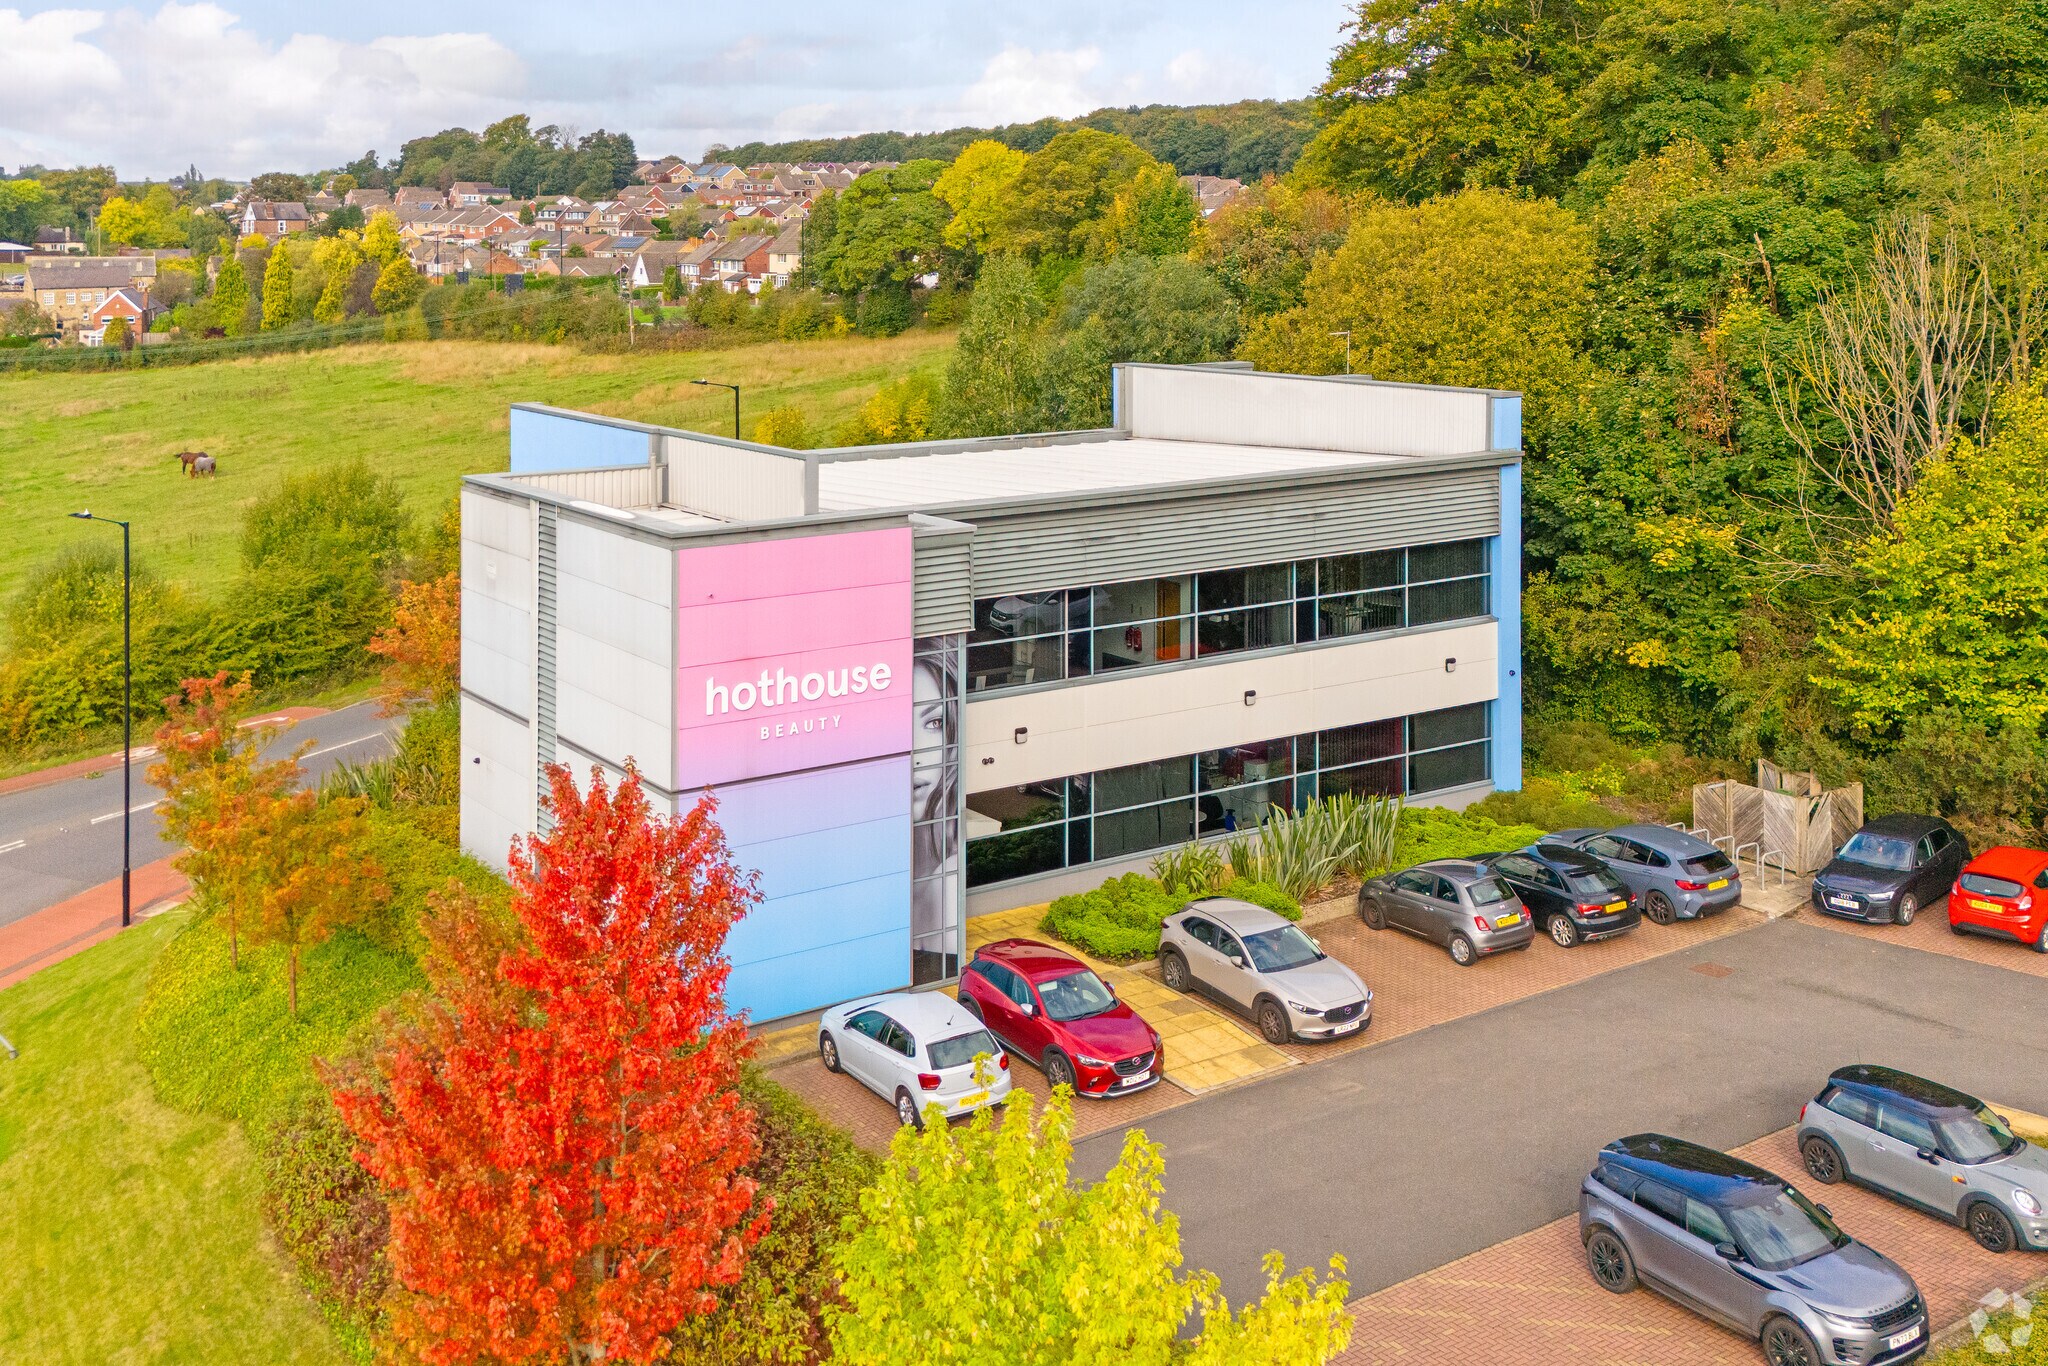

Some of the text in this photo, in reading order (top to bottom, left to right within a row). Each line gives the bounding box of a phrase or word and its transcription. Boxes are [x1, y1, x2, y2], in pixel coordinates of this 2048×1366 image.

[705, 663, 892, 716] hothouse
[760, 715, 842, 740] BEAUTY
[1868, 1304, 1892, 1313] RANGE
